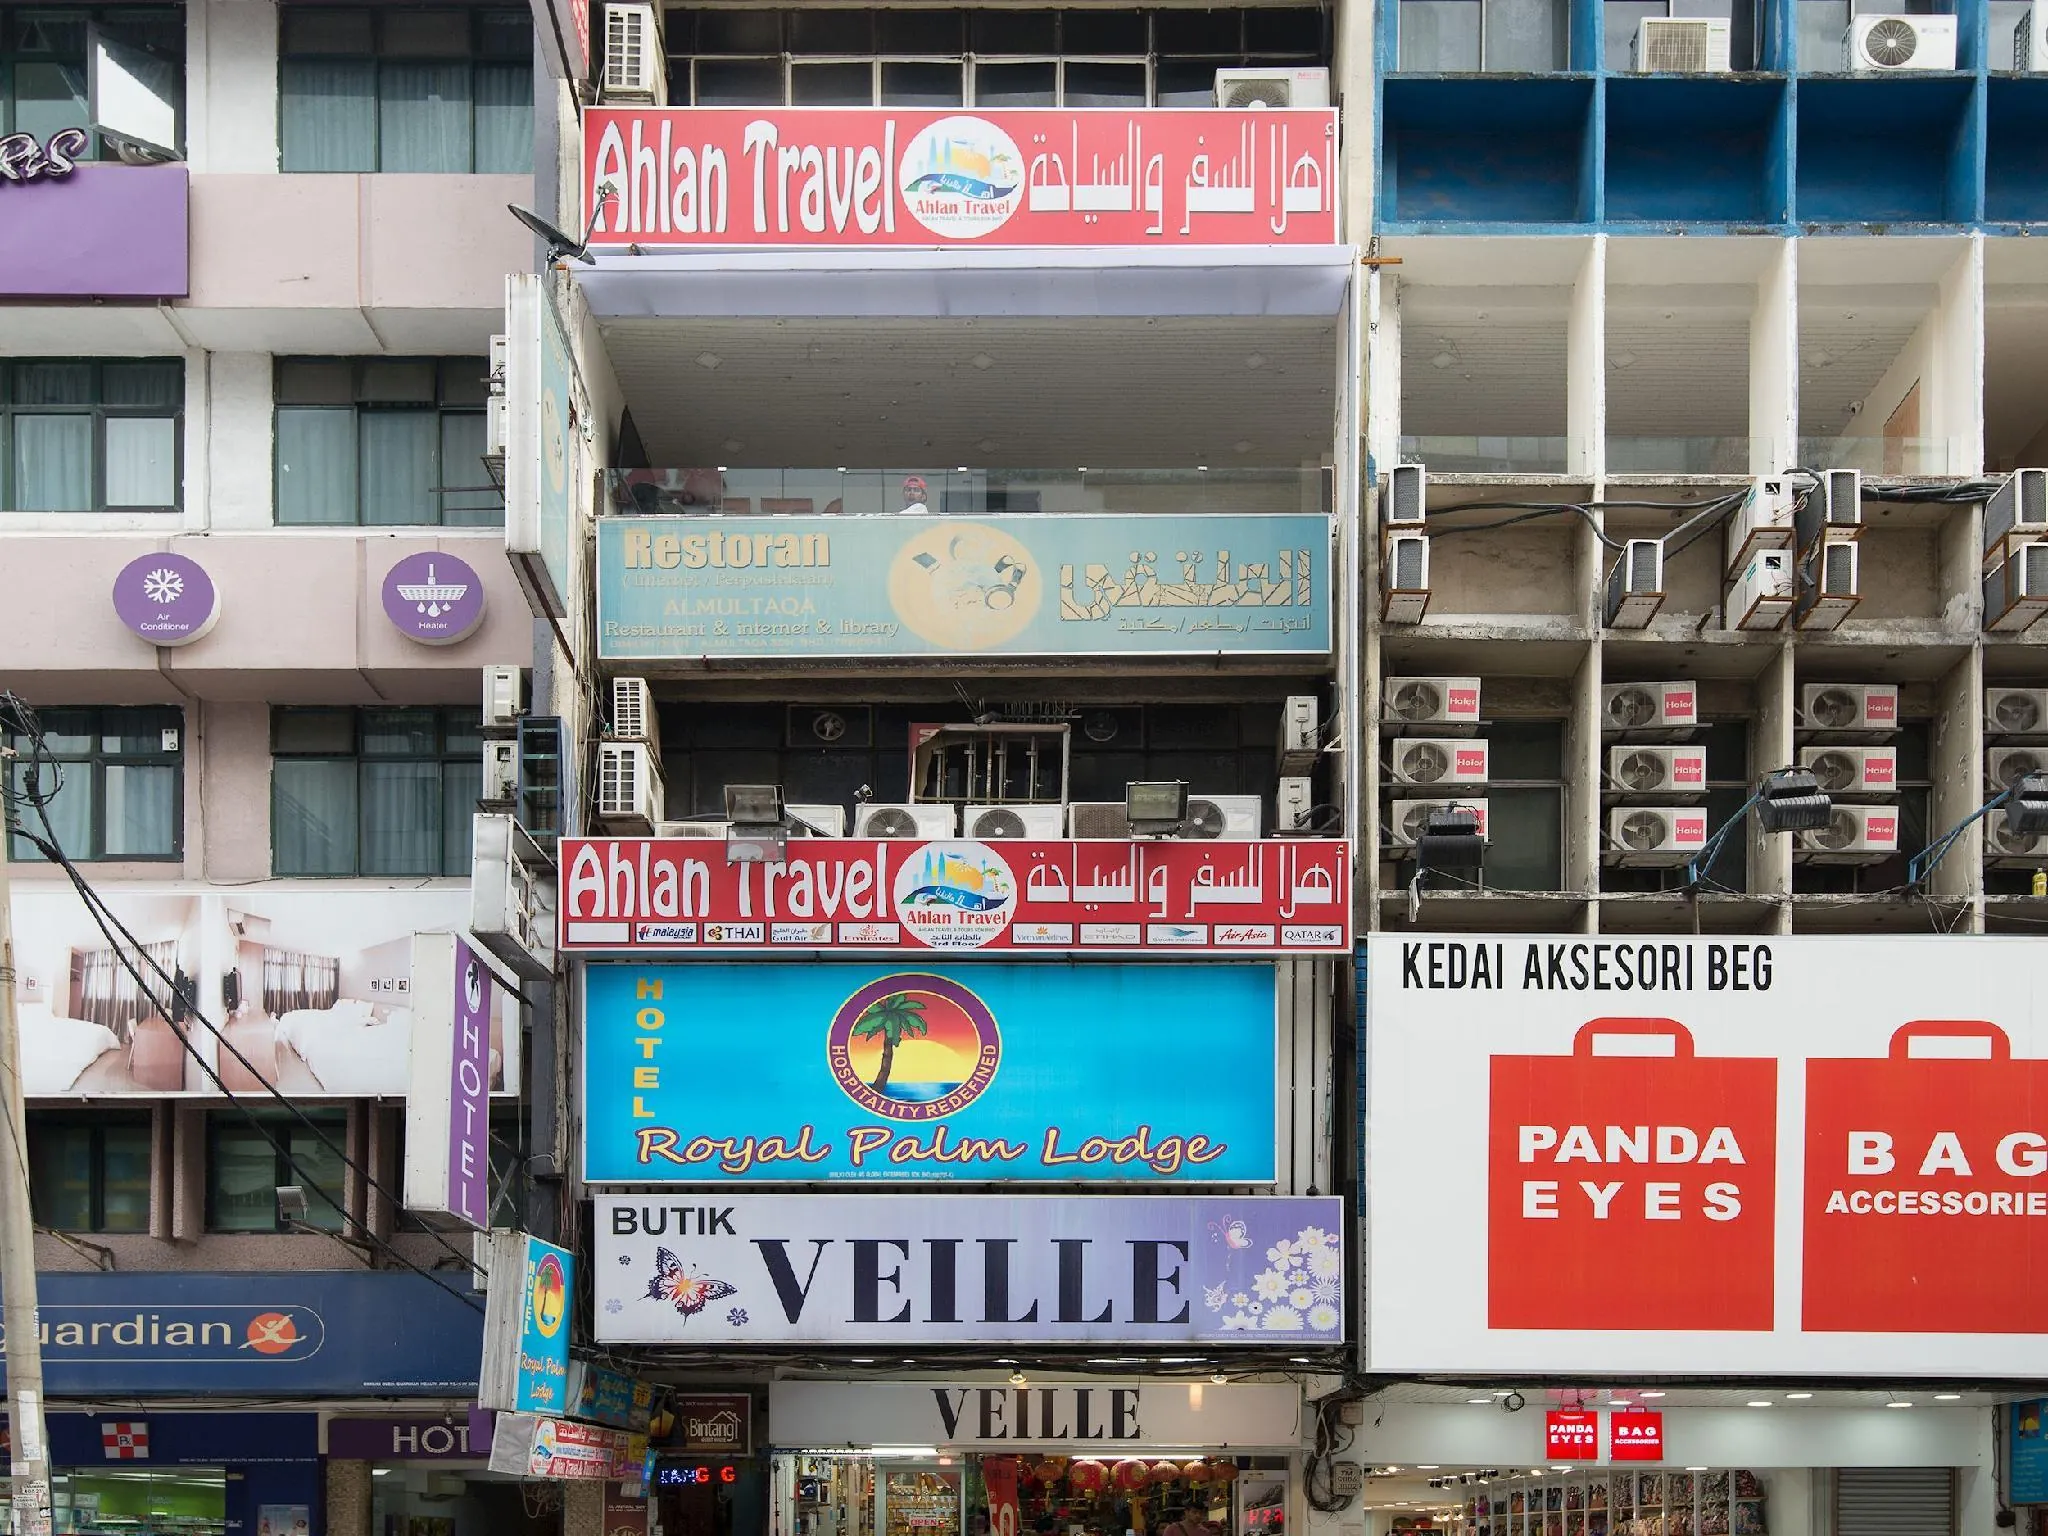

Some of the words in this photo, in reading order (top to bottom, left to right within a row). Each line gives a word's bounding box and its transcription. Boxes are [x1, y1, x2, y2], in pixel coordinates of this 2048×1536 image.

[593, 119, 729, 234] Ahlan
[743, 119, 896, 234] Travel
[1028, 119, 1164, 235] والسياحة
[1179, 119, 1256, 235] للسفر
[1270, 122, 1333, 235] أهلا
[916, 200, 958, 214] Ahlan
[964, 200, 1010, 214] Travel
[623, 527, 831, 570] Restoran
[157, 613, 170, 621] Air
[664, 595, 817, 616] ALMULTAQA
[140, 622, 190, 631] Conditioner
[418, 621, 448, 630] Heater
[604, 620, 706, 638] Restaurant
[713, 619, 730, 636] &
[737, 620, 810, 637] internet
[815, 618, 833, 636] &
[840, 618, 900, 638] library
[1450, 697, 1476, 706] Haier
[1868, 704, 1894, 712] Haier
[1457, 759, 1484, 767] Haier
[1675, 767, 1702, 775] Haier
[1866, 766, 1893, 774] Haier
[1676, 826, 1702, 835] Haier
[1868, 826, 1894, 834] Haier
[568, 842, 711, 918] Ahlan
[727, 842, 888, 919] Travel
[1026, 843, 1167, 918] والسياحة
[1184, 843, 1263, 918] للسفر
[1279, 844, 1344, 918] أهلا
[906, 911, 951, 924] Ahlan
[958, 911, 1006, 924] Travel
[652, 926, 694, 938] malaysia
[724, 927, 760, 939] THAI
[1284, 930, 1321, 939] QATAR
[1402, 943, 1503, 990] KEDAI
[1522, 943, 1693, 991] AKSESORI
[1708, 944, 1772, 991] BEG
[632, 977, 665, 1118] HOTEL
[831, 1044, 921, 1118] HOSPITALITY
[925, 1044, 996, 1117] REDEFINED
[459, 1014, 481, 1219] HOTEL
[636, 1125, 832, 1175] Royal
[847, 1125, 1027, 1168] Palm
[1040, 1125, 1227, 1174] Lodge
[1518, 1125, 1746, 1165] PANDA
[1848, 1130, 2048, 1177] BAG
[1522, 1181, 1742, 1221] EYES
[1825, 1190, 2048, 1216] ACCESSORIE
[612, 1207, 737, 1236] BUTIK
[750, 1239, 1190, 1325] VEILLE
[523, 1260, 535, 1336] HOTEL
[0, 1314, 232, 1352] ardian
[521, 1352, 544, 1376] Royal
[546, 1357, 566, 1377] Palm
[530, 1381, 555, 1404] Lodge
[930, 1388, 1141, 1439] VEILLE
[393, 1426, 469, 1453] HOT
[690, 1418, 735, 1442] Bintang
[1550, 1425, 1594, 1433] PANDA
[1551, 1435, 1594, 1444] EYES
[1618, 1426, 1656, 1436] BAG
